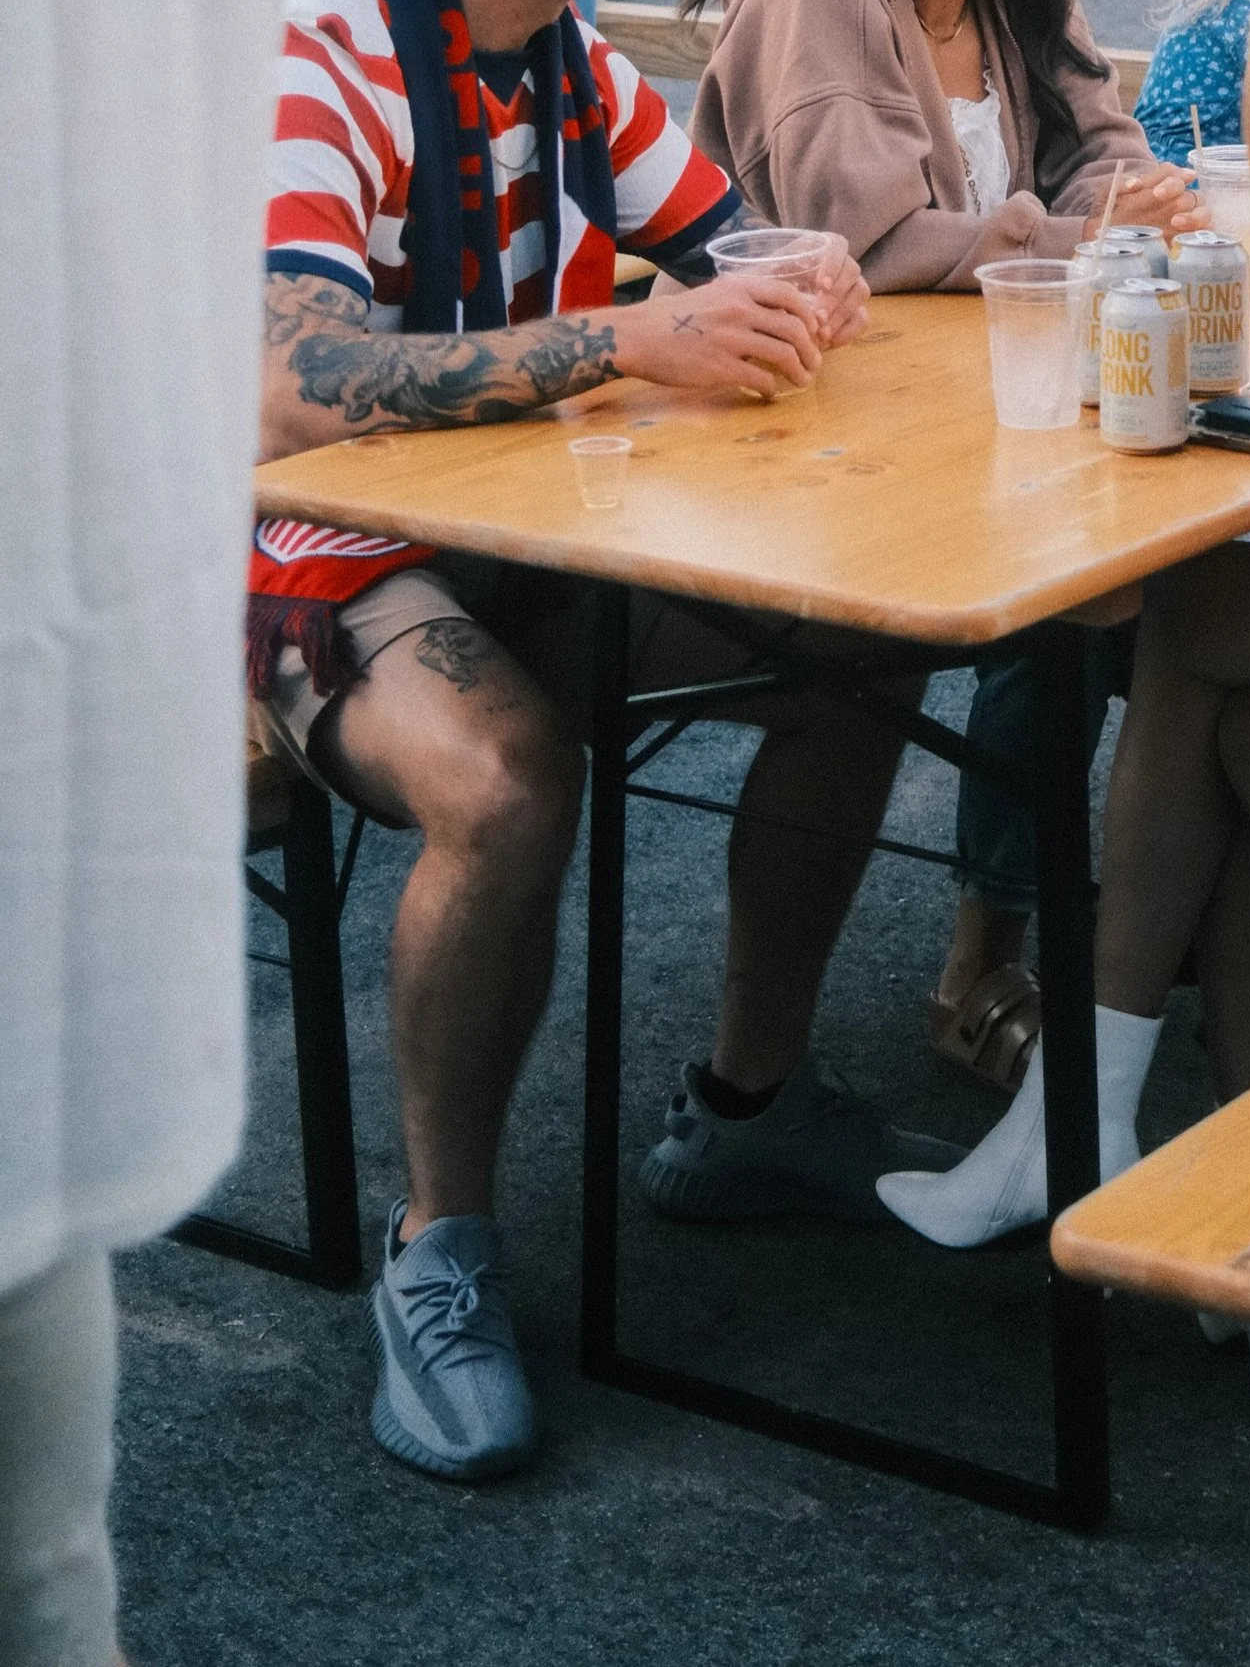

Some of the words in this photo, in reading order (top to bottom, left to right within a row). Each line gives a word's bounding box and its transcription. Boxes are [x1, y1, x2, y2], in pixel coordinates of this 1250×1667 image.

[1187, 281, 1243, 313] LONG
[1103, 329, 1150, 363] ONG
[1103, 364, 1154, 396] RINK
